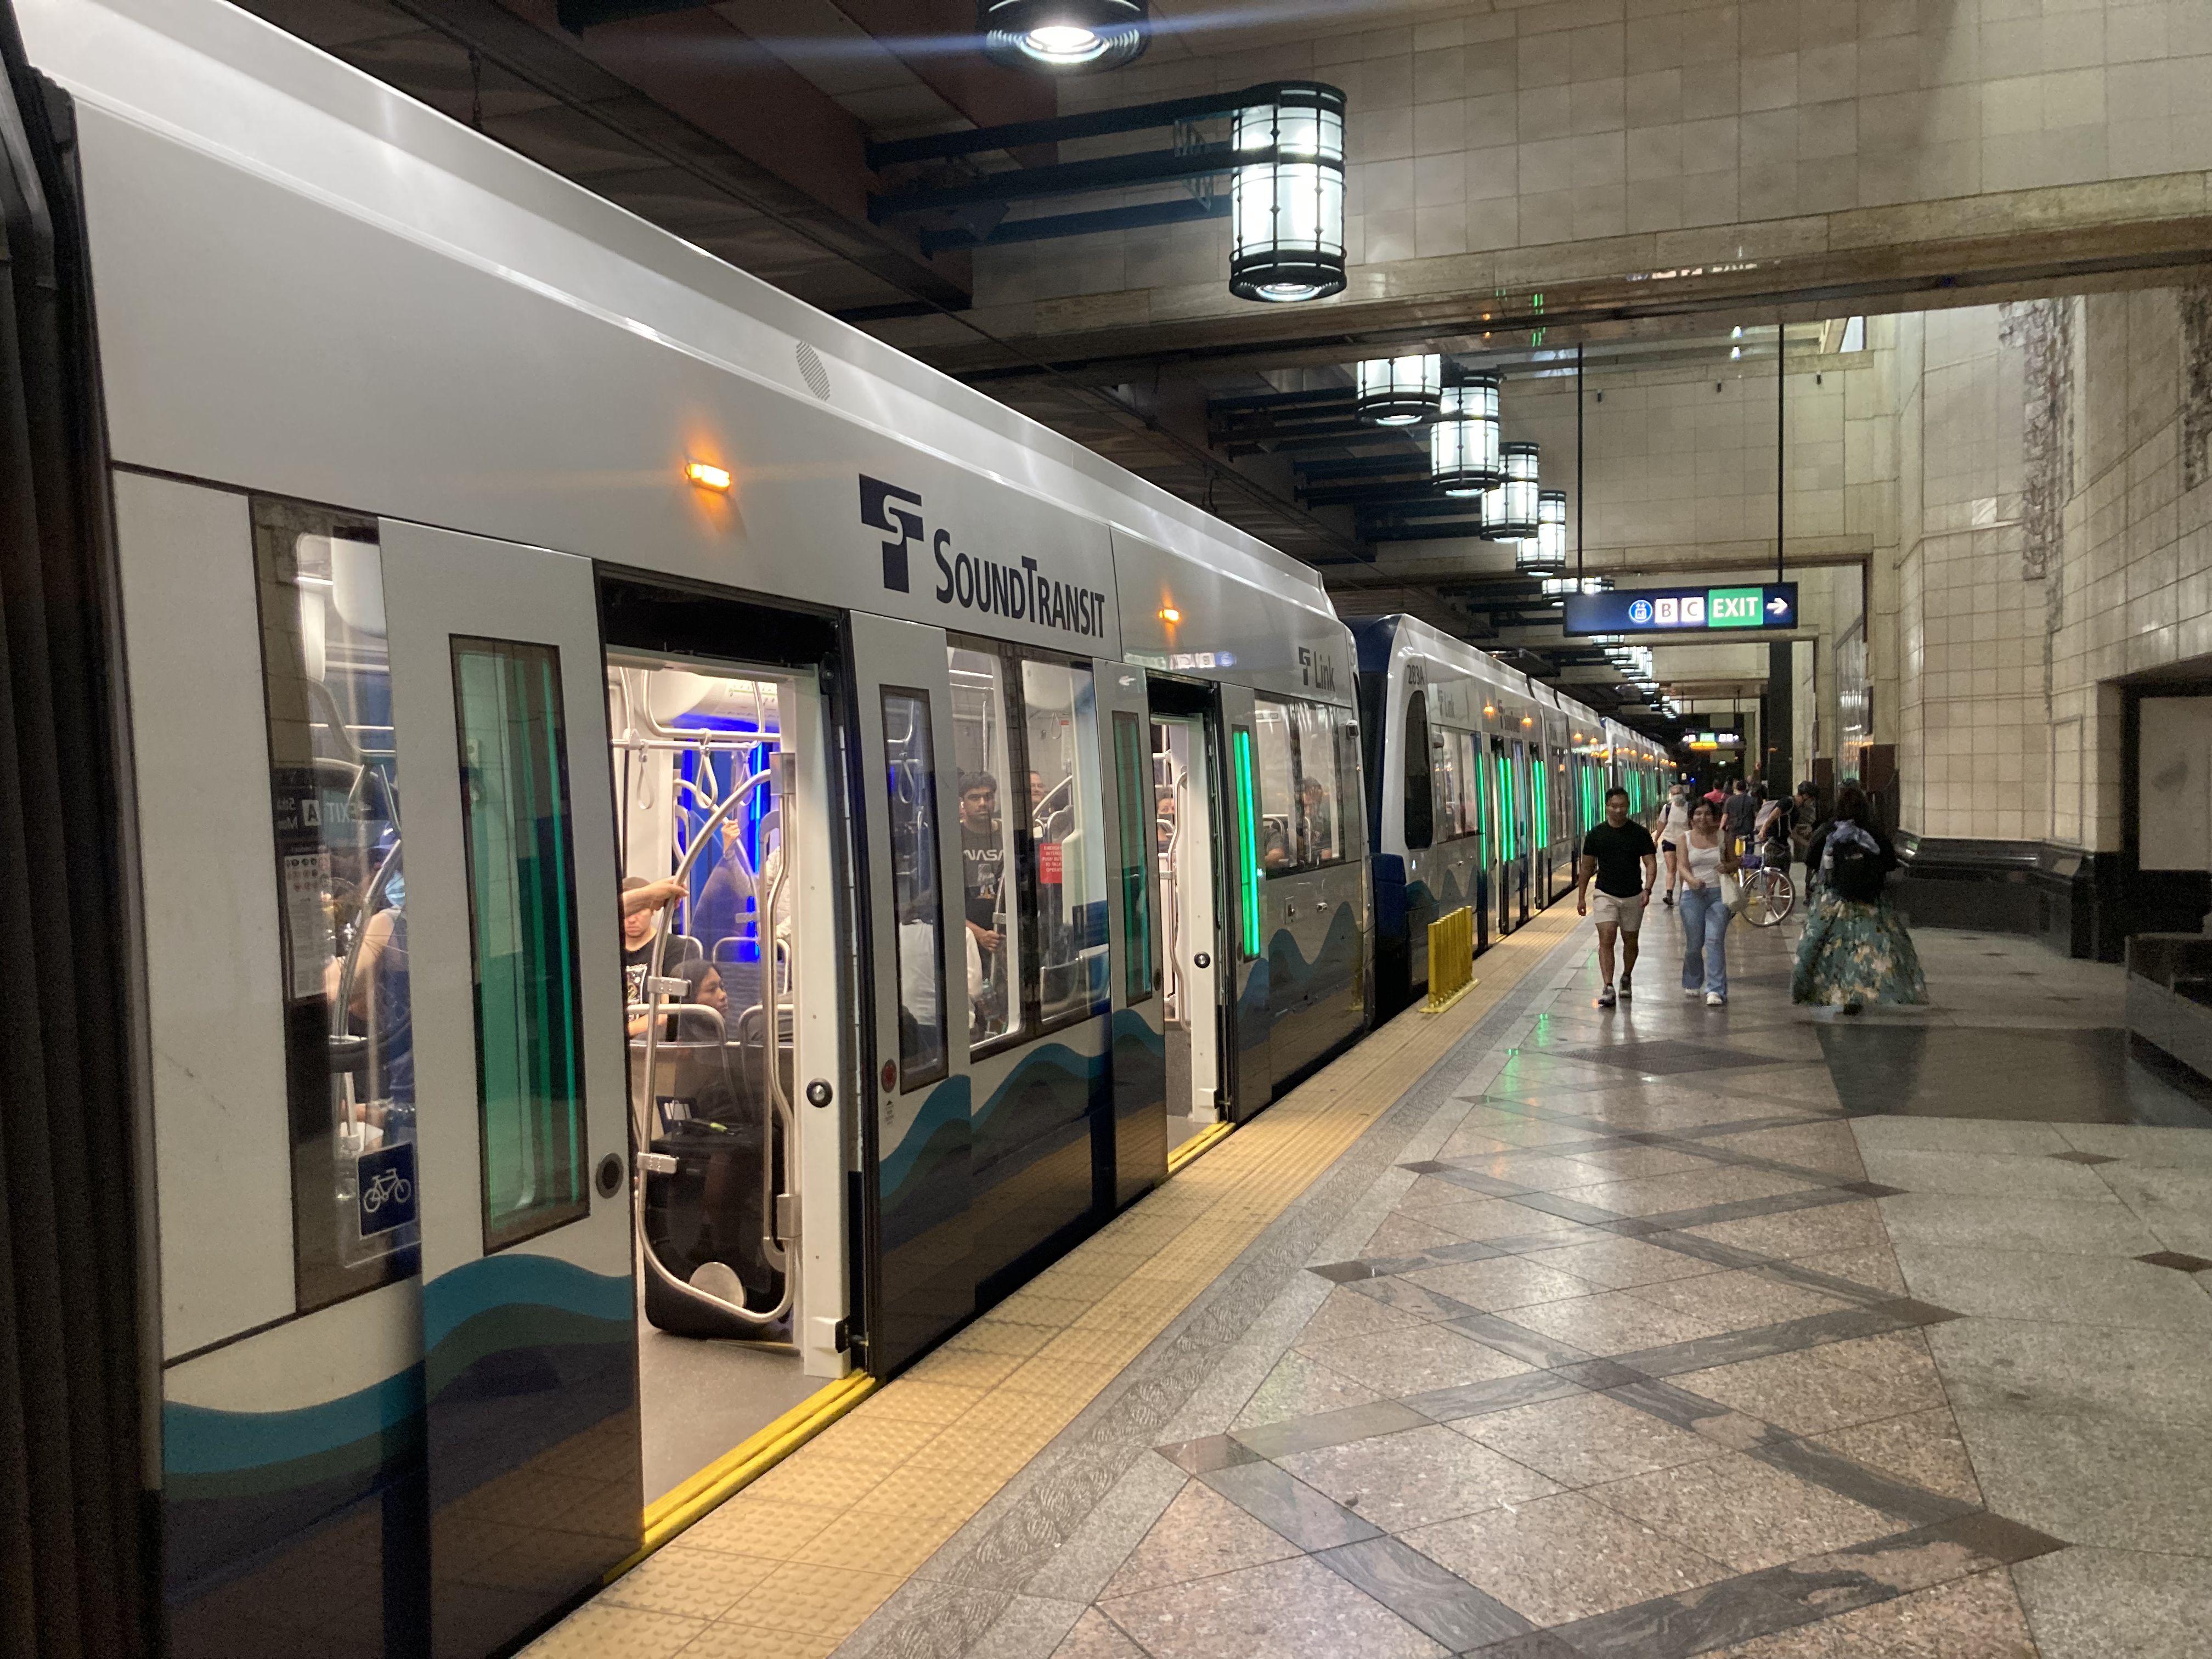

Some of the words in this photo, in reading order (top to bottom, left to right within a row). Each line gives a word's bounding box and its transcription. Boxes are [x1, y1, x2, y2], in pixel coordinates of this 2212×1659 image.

[1661, 603, 1672, 617] B
[1687, 601, 1698, 617] C
[1713, 596, 1758, 618] EXIT
[1314, 651, 1335, 692] Link
[1407, 664, 1425, 686] 283A
